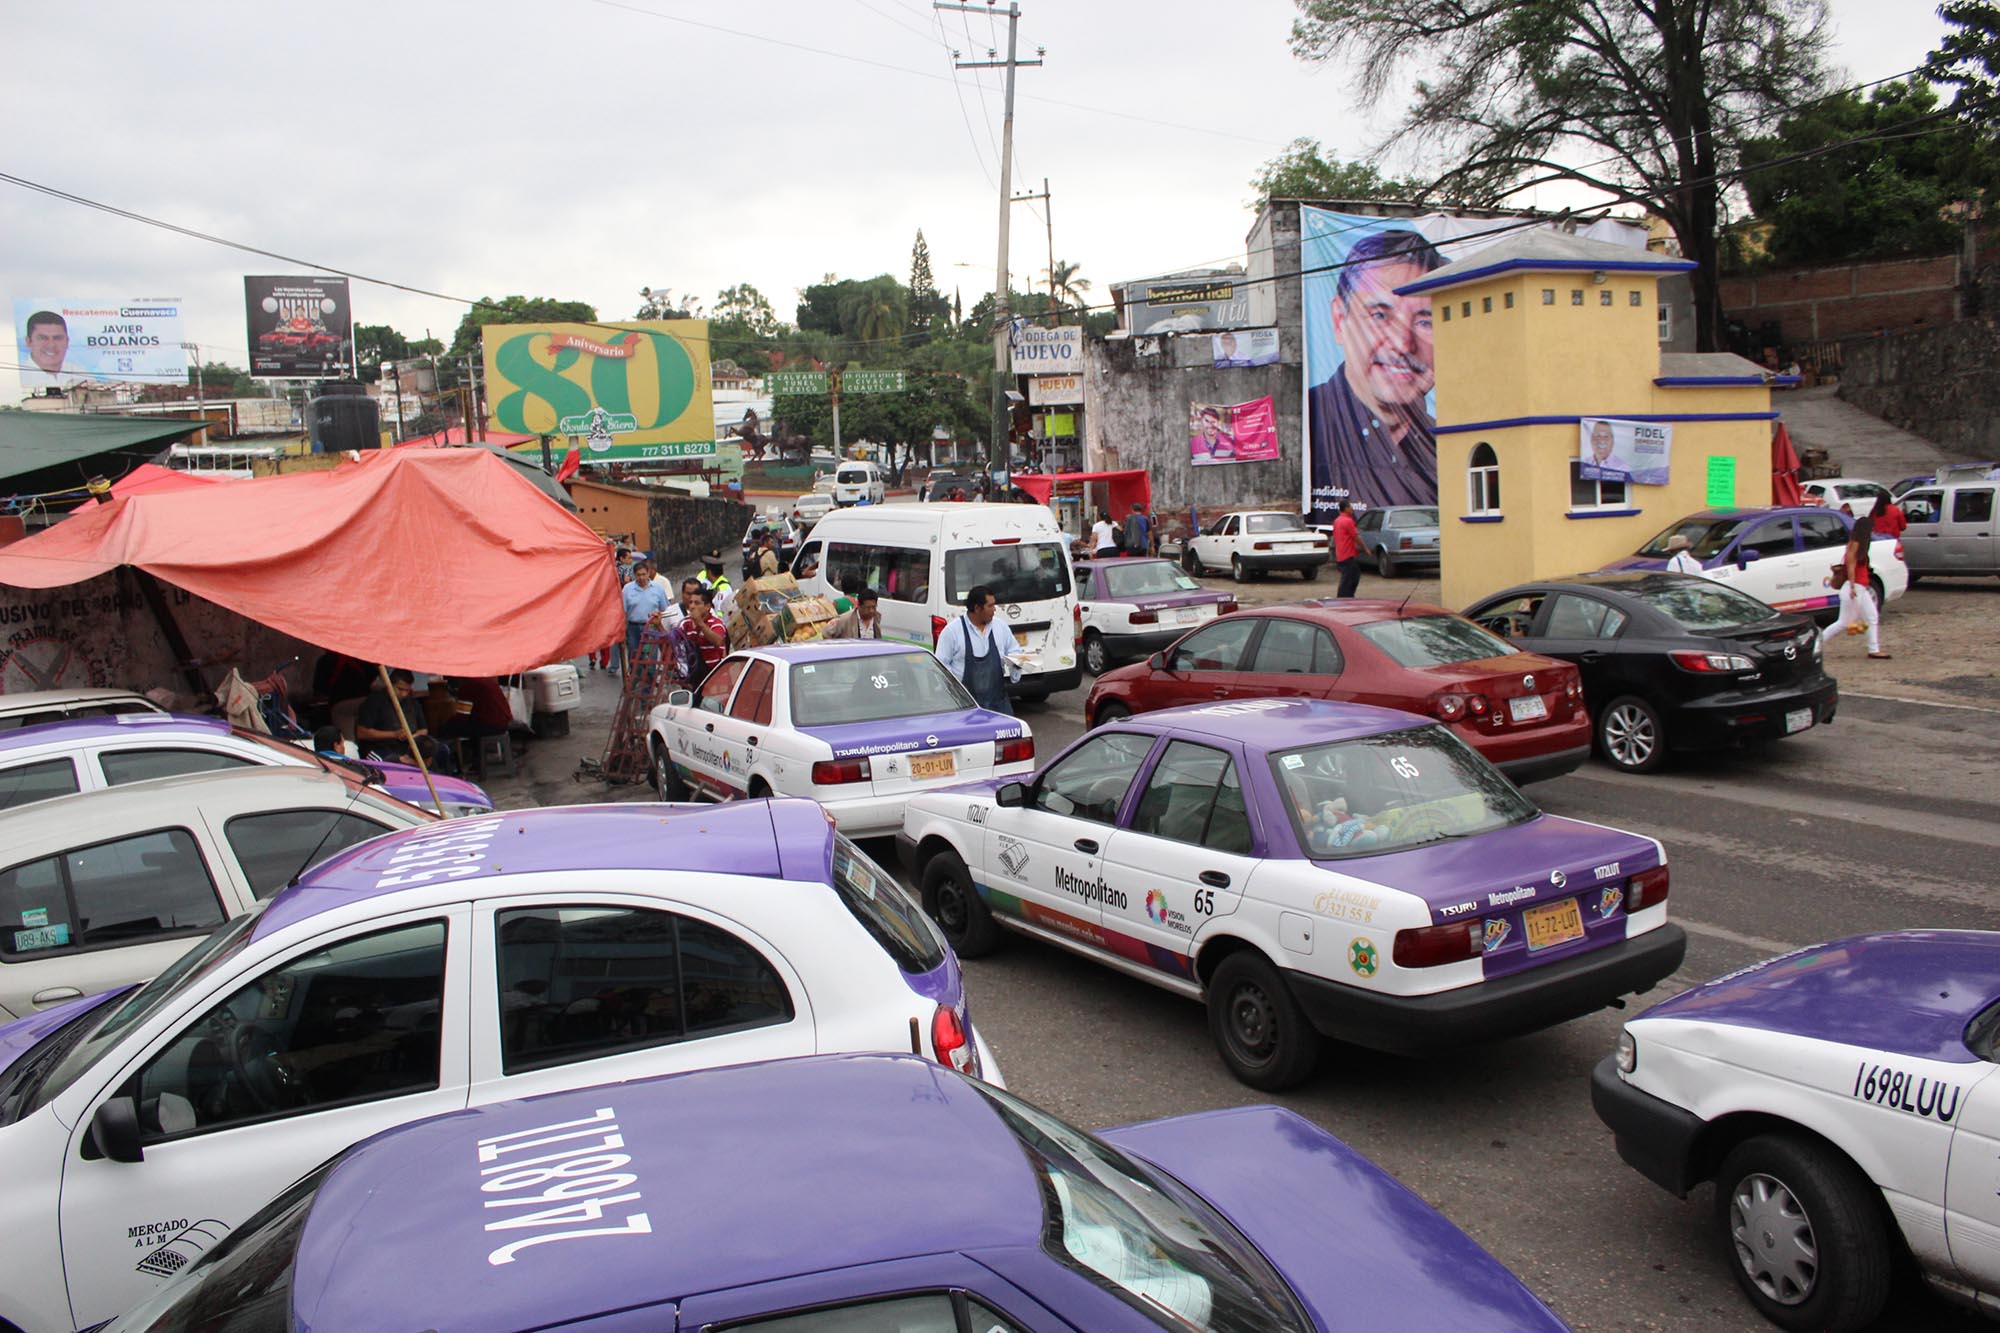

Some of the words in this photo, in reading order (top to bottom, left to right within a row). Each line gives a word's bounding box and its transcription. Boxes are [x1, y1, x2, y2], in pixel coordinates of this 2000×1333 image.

[62, 309, 118, 317] Rescatemos
[122, 308, 176, 317] Cuernavaca
[102, 325, 144, 334] JAVIER
[1022, 330, 1059, 342] ODEGA
[1063, 331, 1076, 341] DE
[566, 336, 625, 357] Aniversario
[1014, 344, 1072, 361] HUEVO
[495, 328, 695, 436] 80
[1038, 379, 1076, 391] HUEVO
[1634, 427, 1665, 439] FIDEL
[642, 447, 659, 457] 777
[661, 444, 680, 456] 311
[684, 442, 711, 455] 6279
[870, 674, 889, 690] 39
[835, 748, 862, 757] TSURU
[860, 741, 920, 754] Metropolitano
[911, 757, 953, 774] 20-01-LUV
[1390, 755, 1420, 779] 65
[1594, 862, 1621, 880] 1172LUT
[1055, 865, 1128, 911] Metropolitano
[1194, 888, 1215, 916] 65
[1439, 901, 1477, 917] TSURU
[1488, 886, 1536, 906] Metropolitano
[1167, 910, 1185, 922] VISION
[1328, 902, 1346, 918] 321
[1167, 920, 1192, 935] MORELOS
[1528, 909, 1579, 938] 11-72-LUT
[1853, 1062, 1960, 1122] 1698LUU
[128, 1219, 189, 1238] MERCADO
[135, 1239, 143, 1248] A
[146, 1237, 154, 1246] L
[156, 1234, 167, 1244] M
